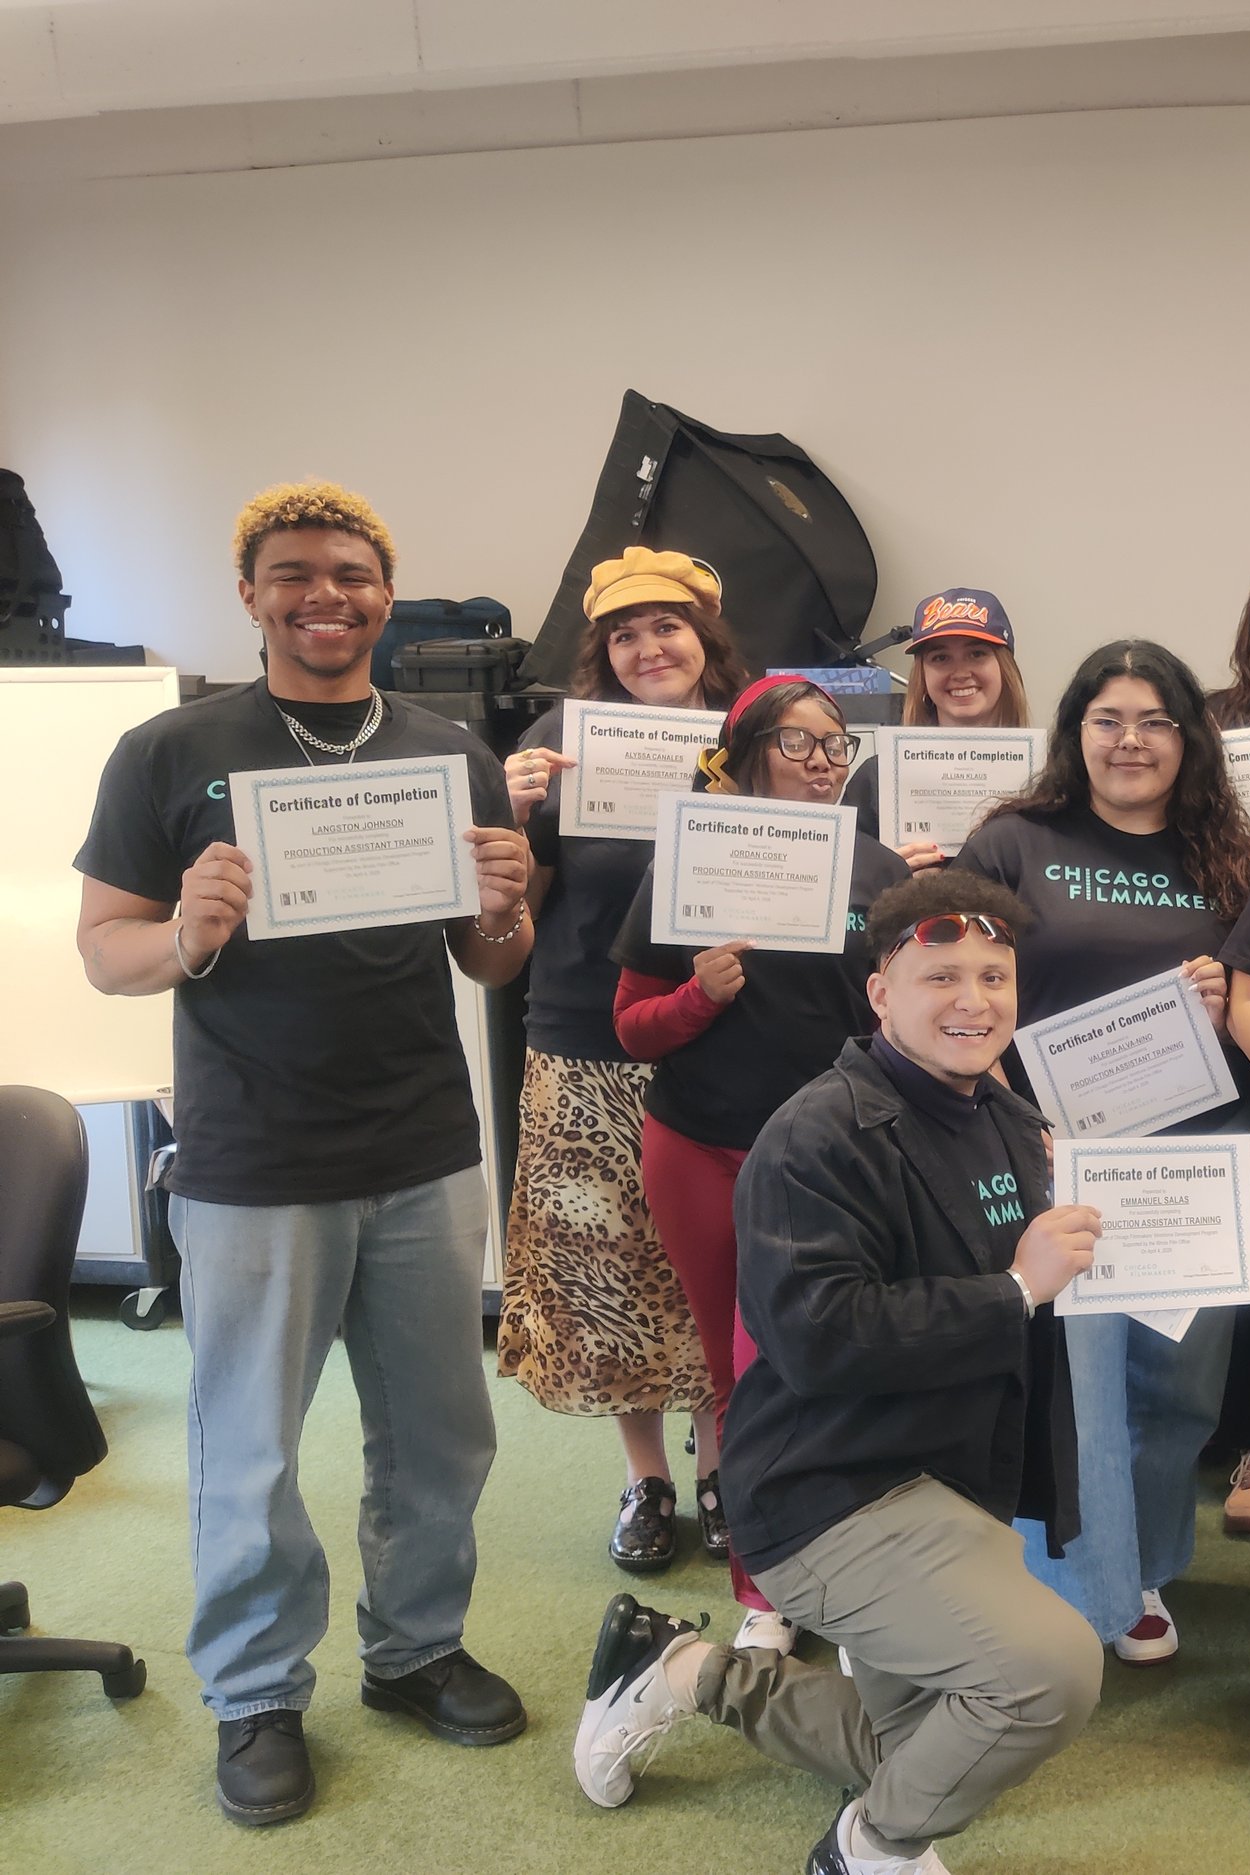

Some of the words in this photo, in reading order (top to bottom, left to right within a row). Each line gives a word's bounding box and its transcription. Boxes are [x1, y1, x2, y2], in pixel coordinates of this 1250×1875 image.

[921, 596, 988, 632] Bears
[590, 725, 645, 739] Certificate
[648, 729, 658, 740] of
[661, 730, 718, 745] Completion
[625, 751, 650, 760] ALYSSA
[651, 753, 684, 762] CANALES
[904, 750, 955, 761] Certificate
[957, 750, 968, 761] of
[970, 750, 1024, 763] Completion
[595, 767, 639, 777] PRODUCTION
[640, 769, 678, 779] ASSISTANT
[269, 798, 342, 813] Certificate
[346, 793, 360, 807] of
[363, 788, 438, 807] Completion
[311, 822, 360, 835] LANGSTON
[362, 818, 404, 830] JOHNSON
[687, 819, 749, 836] Certificate
[752, 825, 764, 837] of
[767, 826, 829, 842] Completion
[283, 845, 342, 859] PRODUCTION
[345, 841, 392, 853] ASSISTANT
[394, 836, 434, 849] TRAINING
[730, 849, 761, 859] JORDAN
[762, 851, 788, 861] COSEY
[692, 866, 743, 877] PRODUCTION
[744, 870, 785, 881] ASSISTANT
[786, 872, 818, 883] TRAINING
[1045, 864, 1170, 889] CHICAGO
[1048, 1027, 1104, 1056] Certificate
[1106, 1020, 1117, 1034] of
[1118, 999, 1177, 1029] Completion
[1088, 1047, 1118, 1064] VALERIA
[1070, 1068, 1114, 1090] PRODUCTION
[1115, 1055, 1151, 1074] ASSISTANT
[1152, 1041, 1184, 1060] TRAINING
[1084, 1168, 1143, 1183] Certificate
[1146, 1167, 1157, 1180] of
[1161, 1165, 1226, 1182] Completion
[971, 1172, 1017, 1201] AGO
[1120, 1197, 1162, 1206] EMMANUEL
[1163, 1195, 1190, 1204] SALAS
[1102, 1219, 1140, 1229] ODUCTION
[1141, 1217, 1182, 1227] ASSISTANT
[1185, 1215, 1222, 1224] TRAINING
